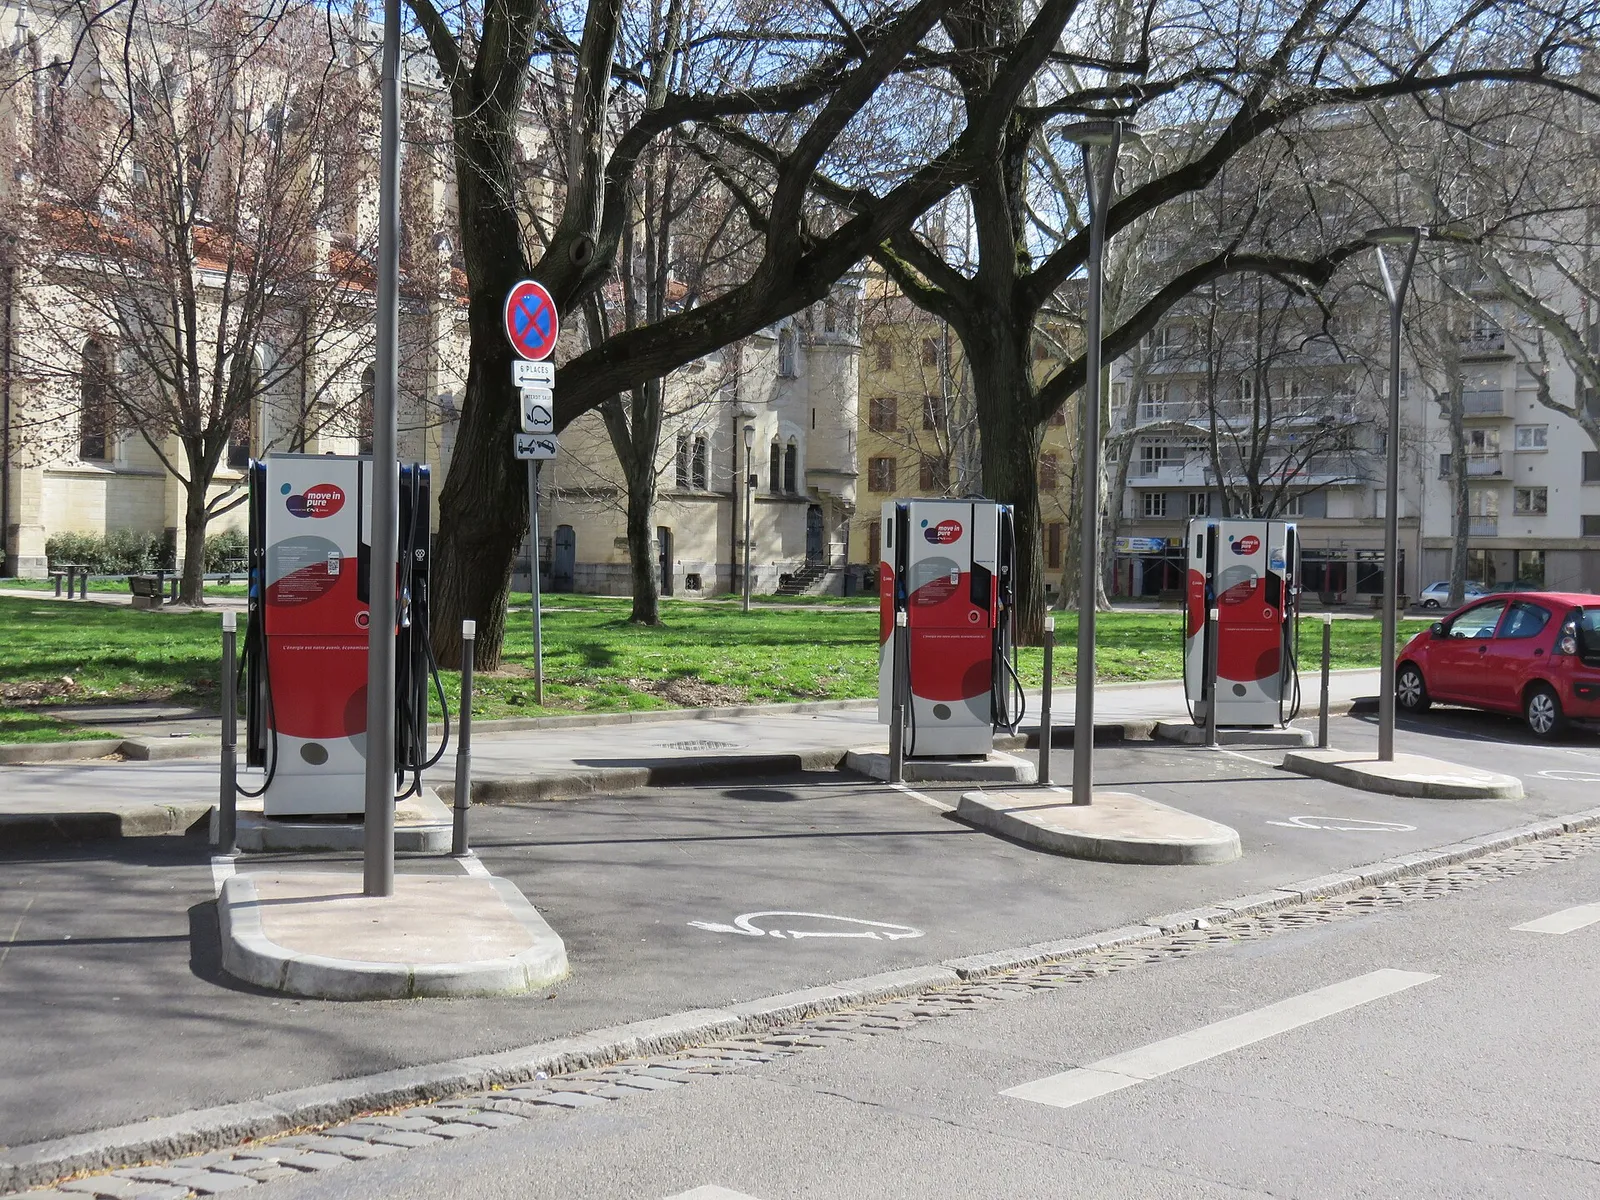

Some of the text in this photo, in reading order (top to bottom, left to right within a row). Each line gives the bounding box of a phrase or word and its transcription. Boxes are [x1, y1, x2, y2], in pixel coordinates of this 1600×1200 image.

[526, 365, 549, 374] PLACES
[307, 491, 341, 500] move in
[306, 499, 327, 507] pure
